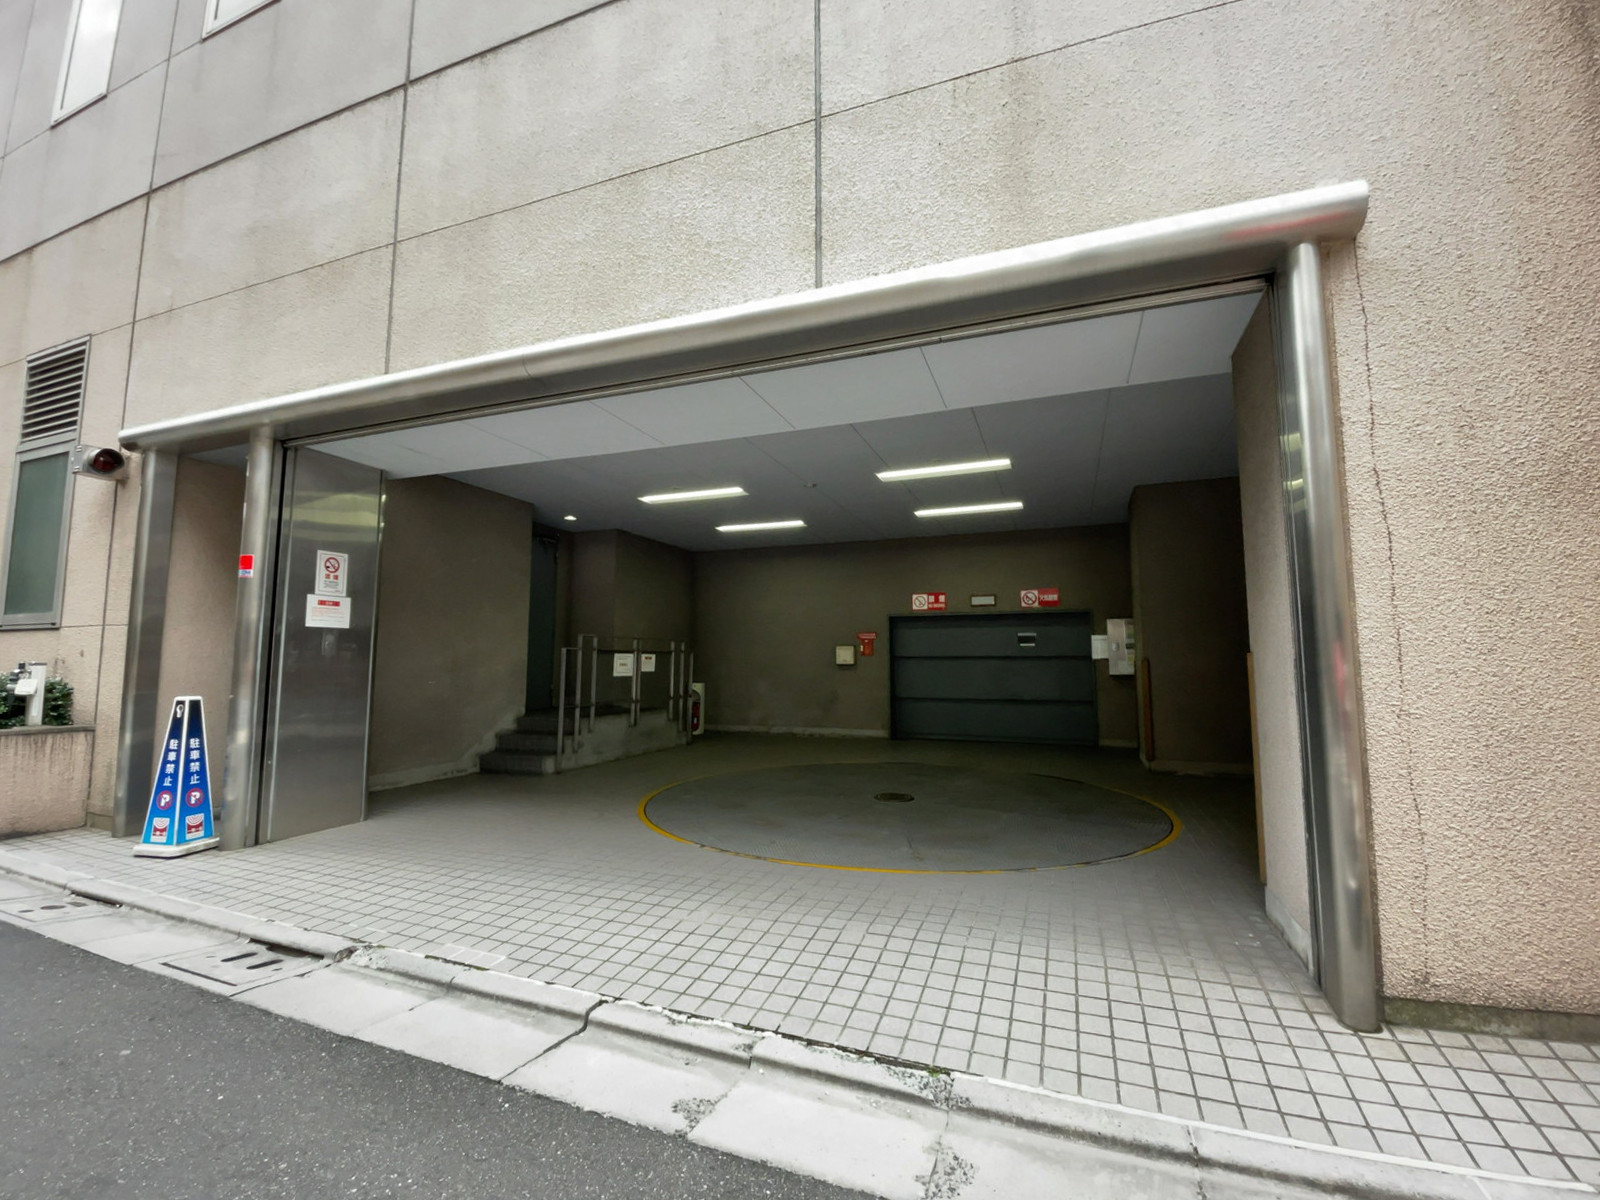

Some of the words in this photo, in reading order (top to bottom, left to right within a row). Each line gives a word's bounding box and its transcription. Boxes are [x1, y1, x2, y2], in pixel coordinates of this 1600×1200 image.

[163, 739, 179, 787] 駐車禁止
[189, 737, 200, 785] 駐車禁止
